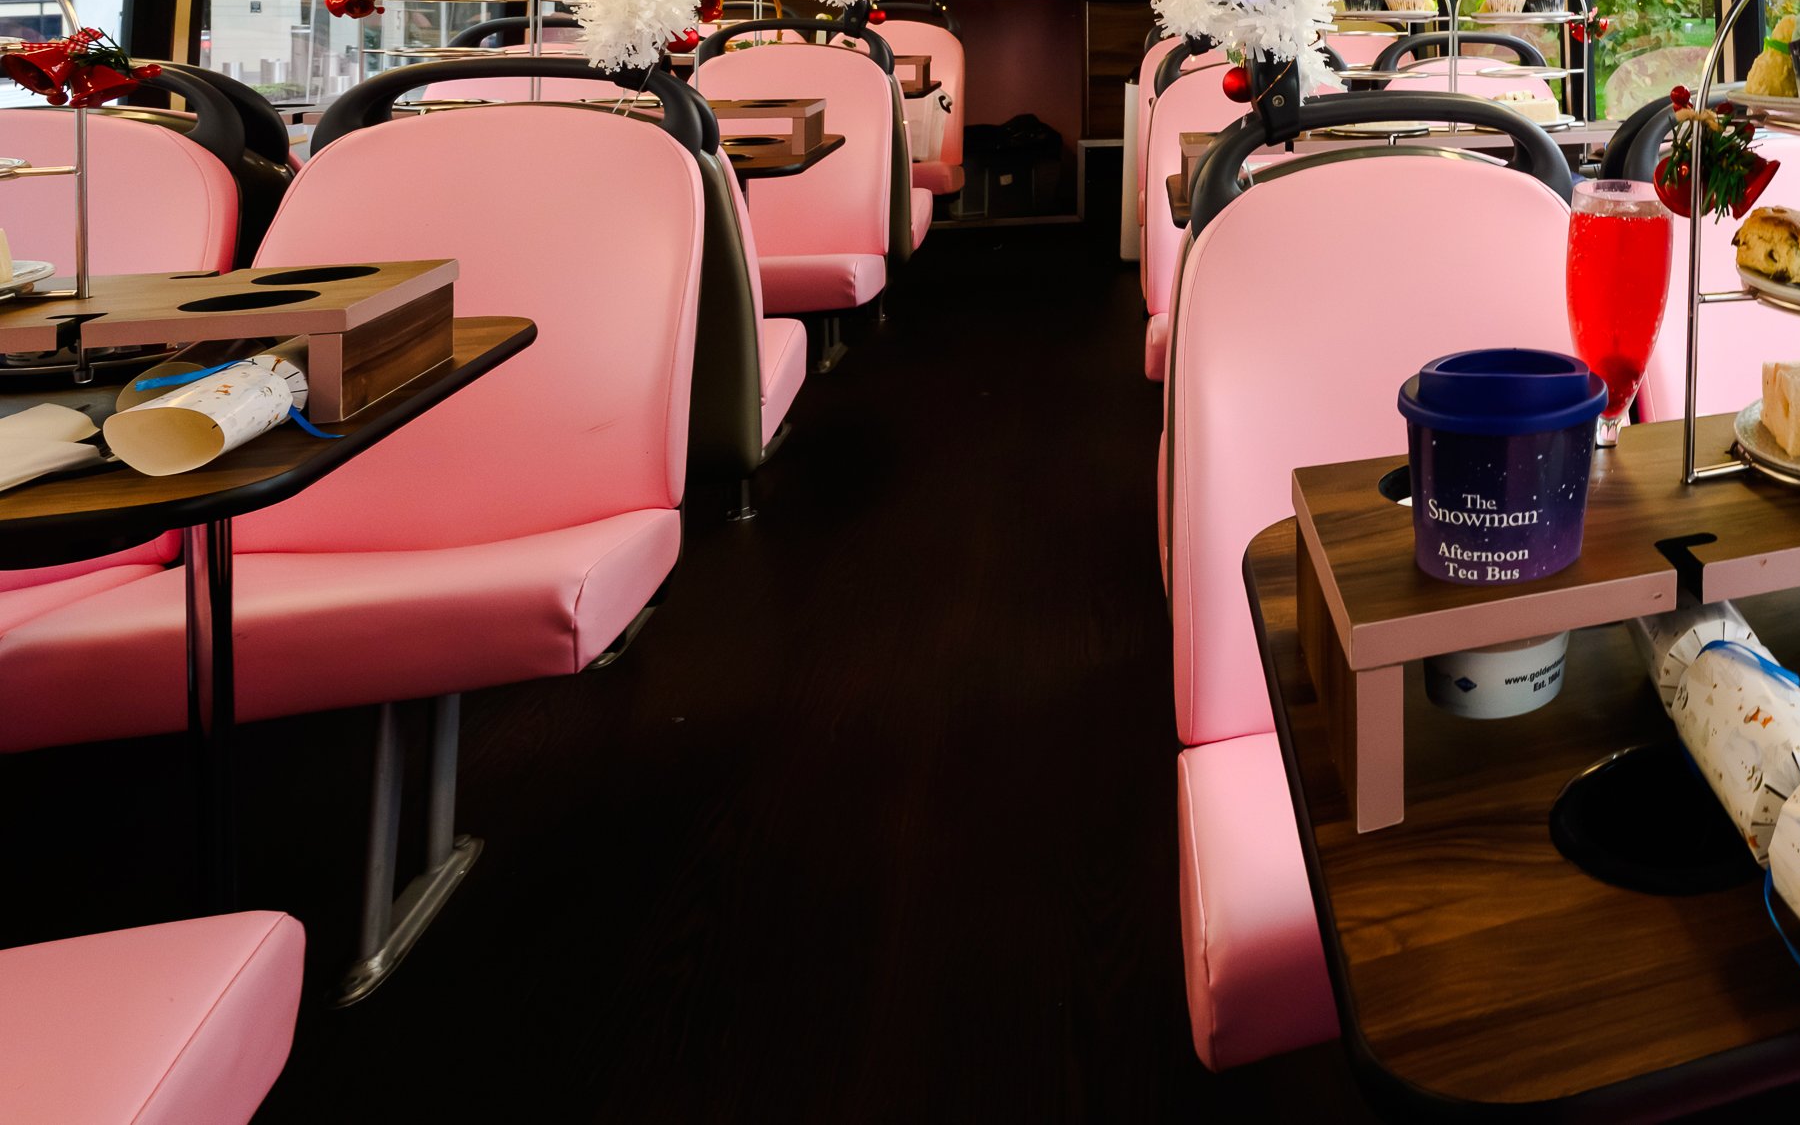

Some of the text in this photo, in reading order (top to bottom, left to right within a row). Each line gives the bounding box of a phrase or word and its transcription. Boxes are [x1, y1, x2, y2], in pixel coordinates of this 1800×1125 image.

[1461, 493, 1498, 511] The
[1428, 498, 1539, 528] Snowman
[1438, 541, 1529, 563] Afternoon
[1444, 561, 1520, 581] Tea Bus
